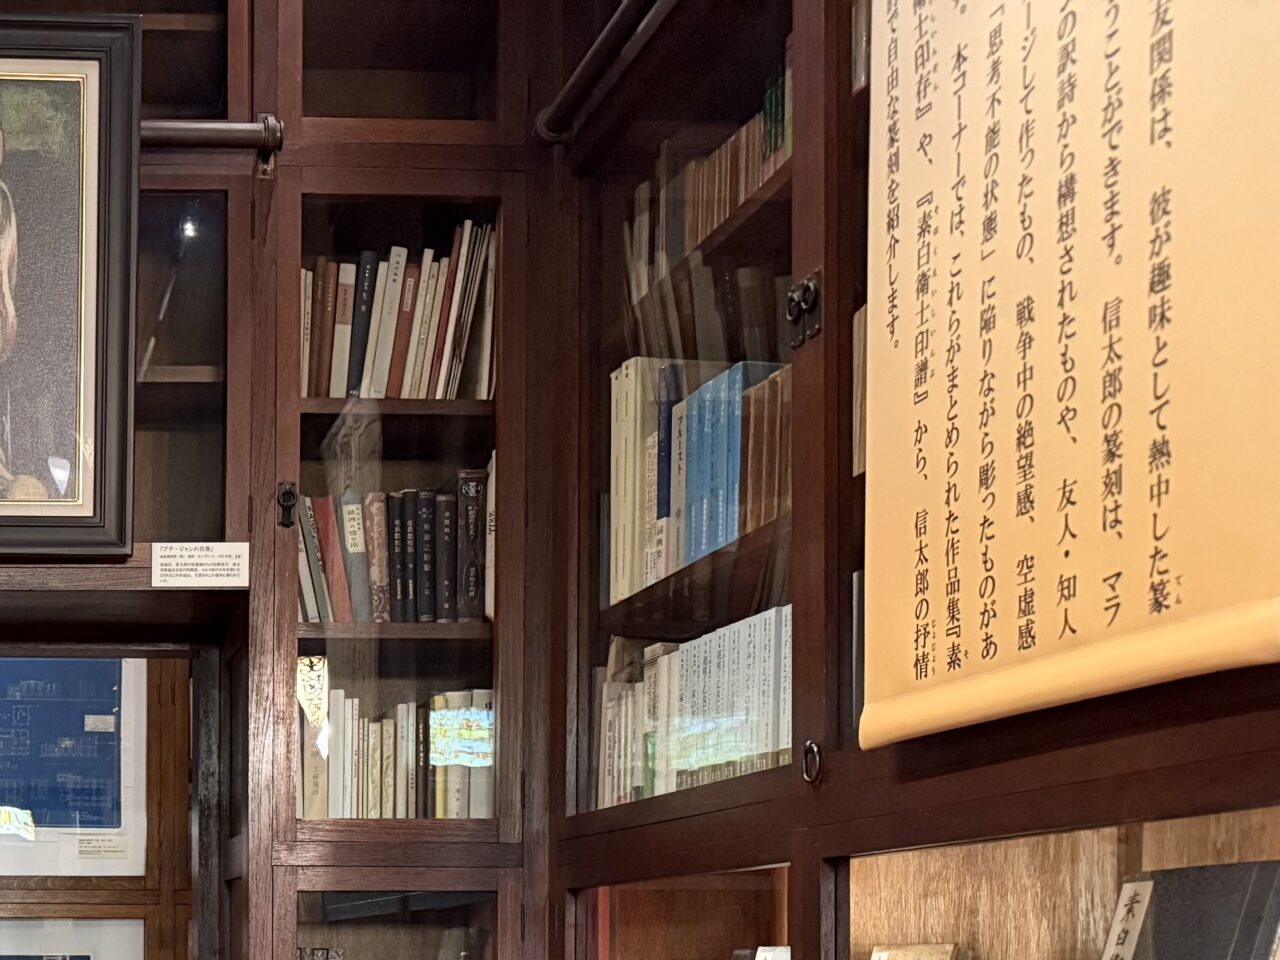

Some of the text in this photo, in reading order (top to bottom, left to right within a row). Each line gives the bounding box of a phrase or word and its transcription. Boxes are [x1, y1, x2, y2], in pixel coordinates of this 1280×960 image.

[944, 0, 968, 673] 。本コーナーでは、これらがまとめられた作品集『素
